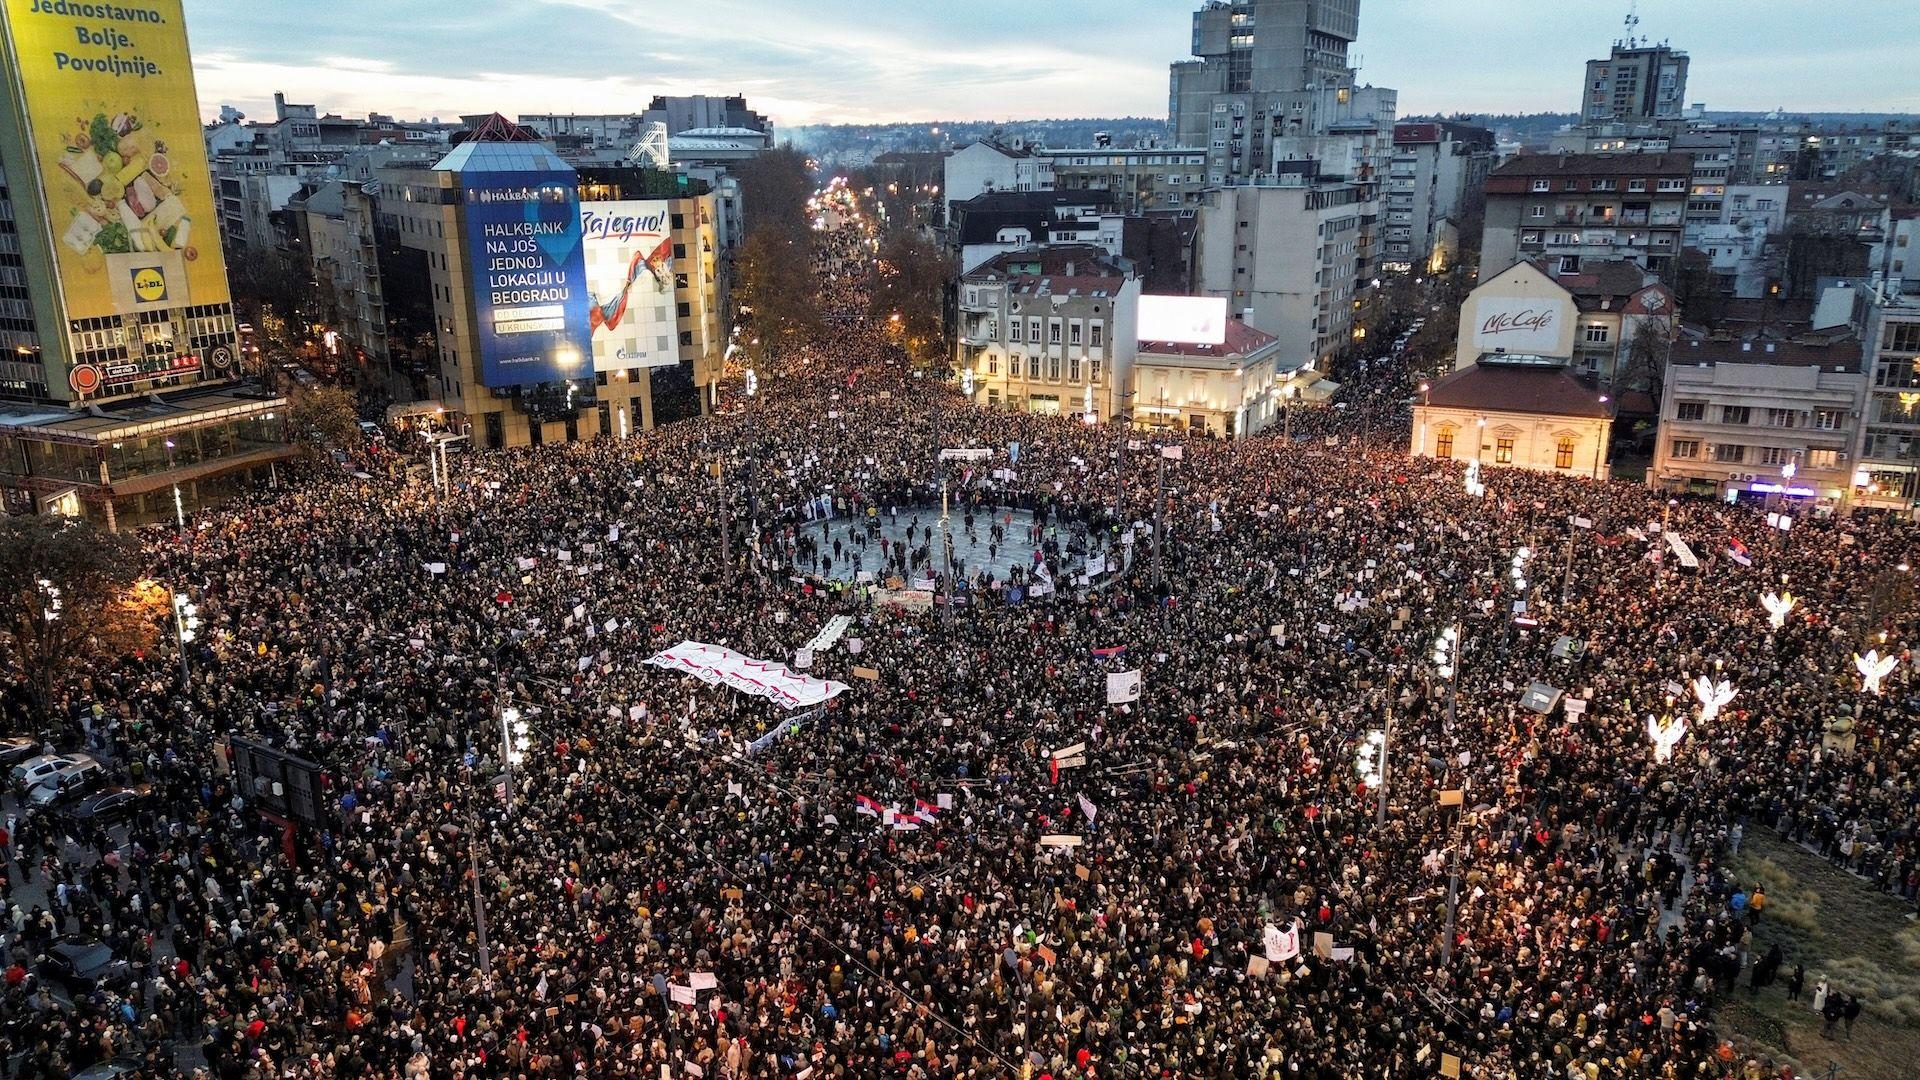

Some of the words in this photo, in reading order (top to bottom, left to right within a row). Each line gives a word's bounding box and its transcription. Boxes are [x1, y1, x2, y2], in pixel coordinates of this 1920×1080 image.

[31, 0, 166, 24] Jednostavno.
[75, 26, 135, 51] Bolje.
[53, 52, 163, 79] Povoljnije.
[491, 191, 540, 202] HALKBANK
[484, 222, 564, 237] HALKBANK
[486, 241, 508, 254] NA
[511, 236, 538, 253] JOŠ
[488, 256, 543, 271] JEDNOJ
[489, 271, 553, 288] LOKACIJI
[555, 271, 566, 284] U
[491, 288, 570, 305] BEOGRADU
